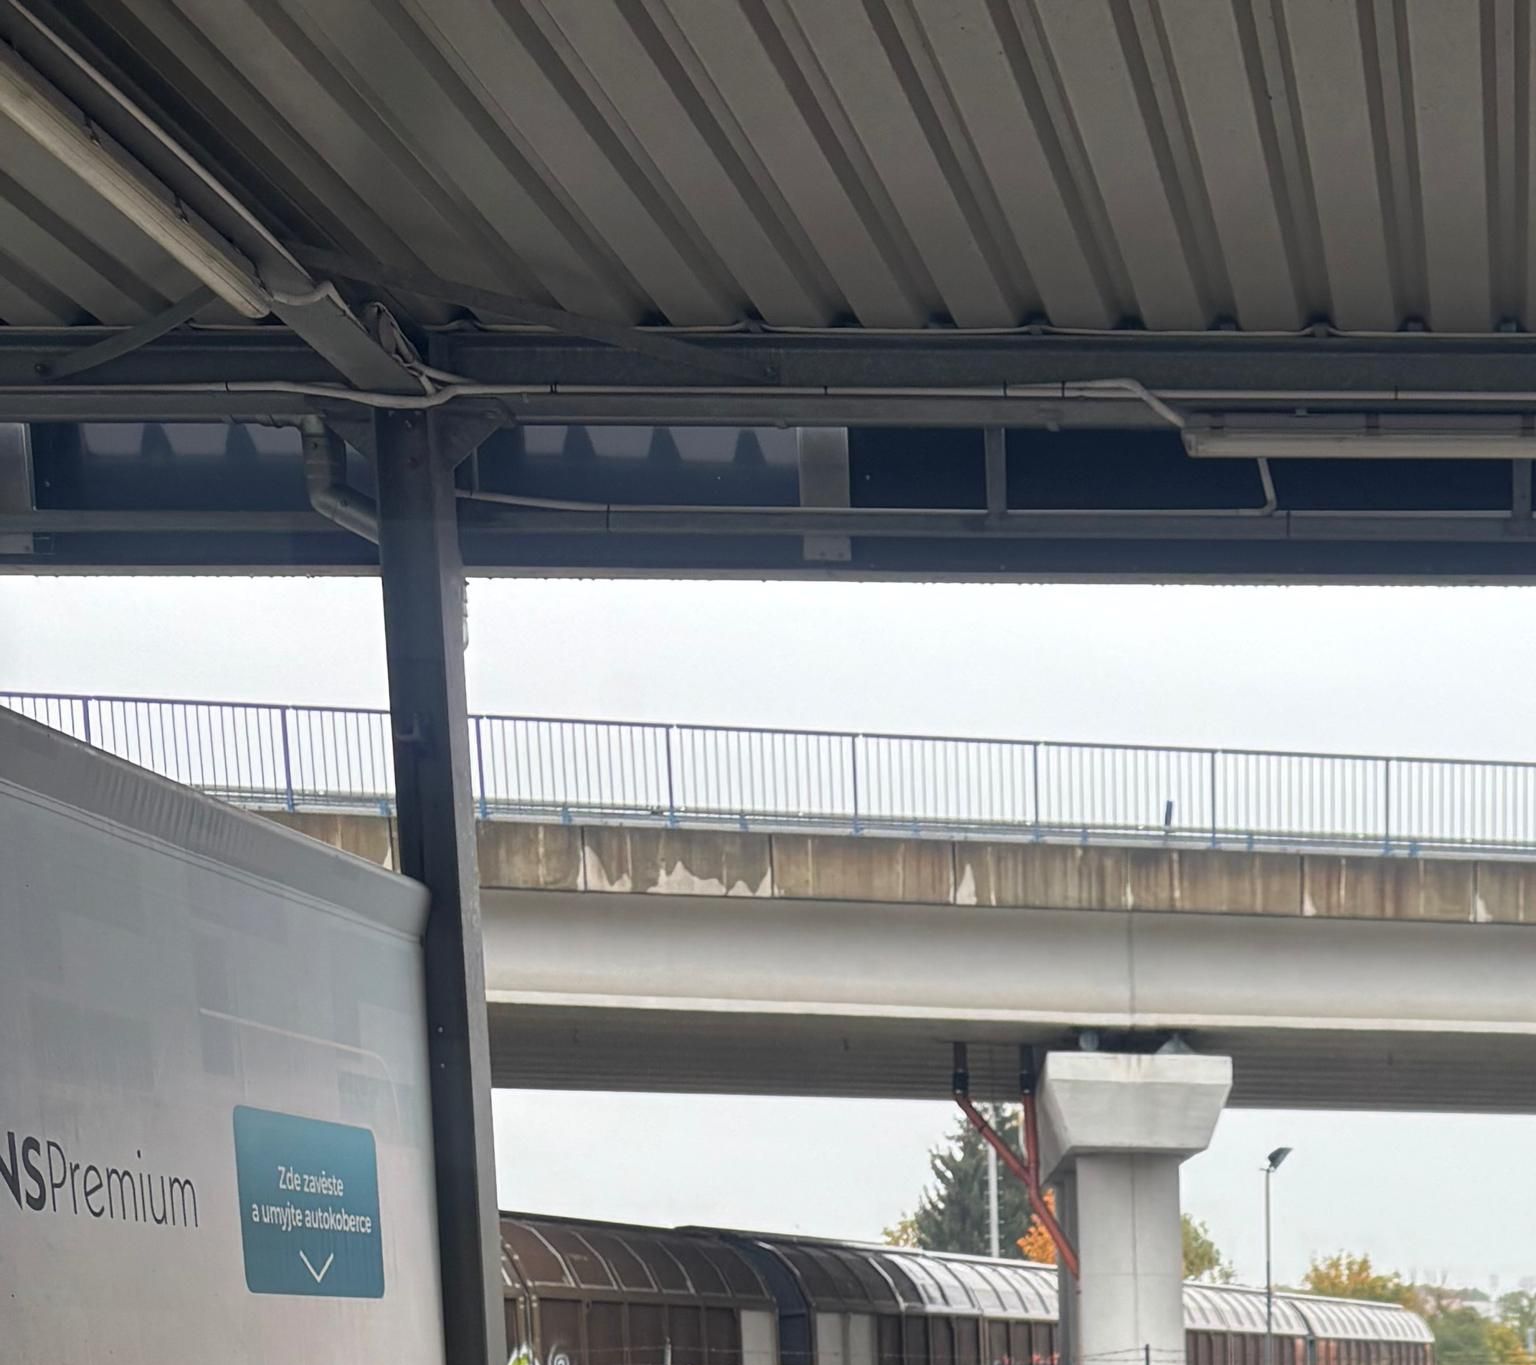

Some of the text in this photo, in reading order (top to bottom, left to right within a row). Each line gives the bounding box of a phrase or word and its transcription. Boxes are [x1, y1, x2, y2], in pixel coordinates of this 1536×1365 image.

[278, 1165, 344, 1197] Zde zavěste
[252, 1201, 372, 1233] a umyjte autokoberce
